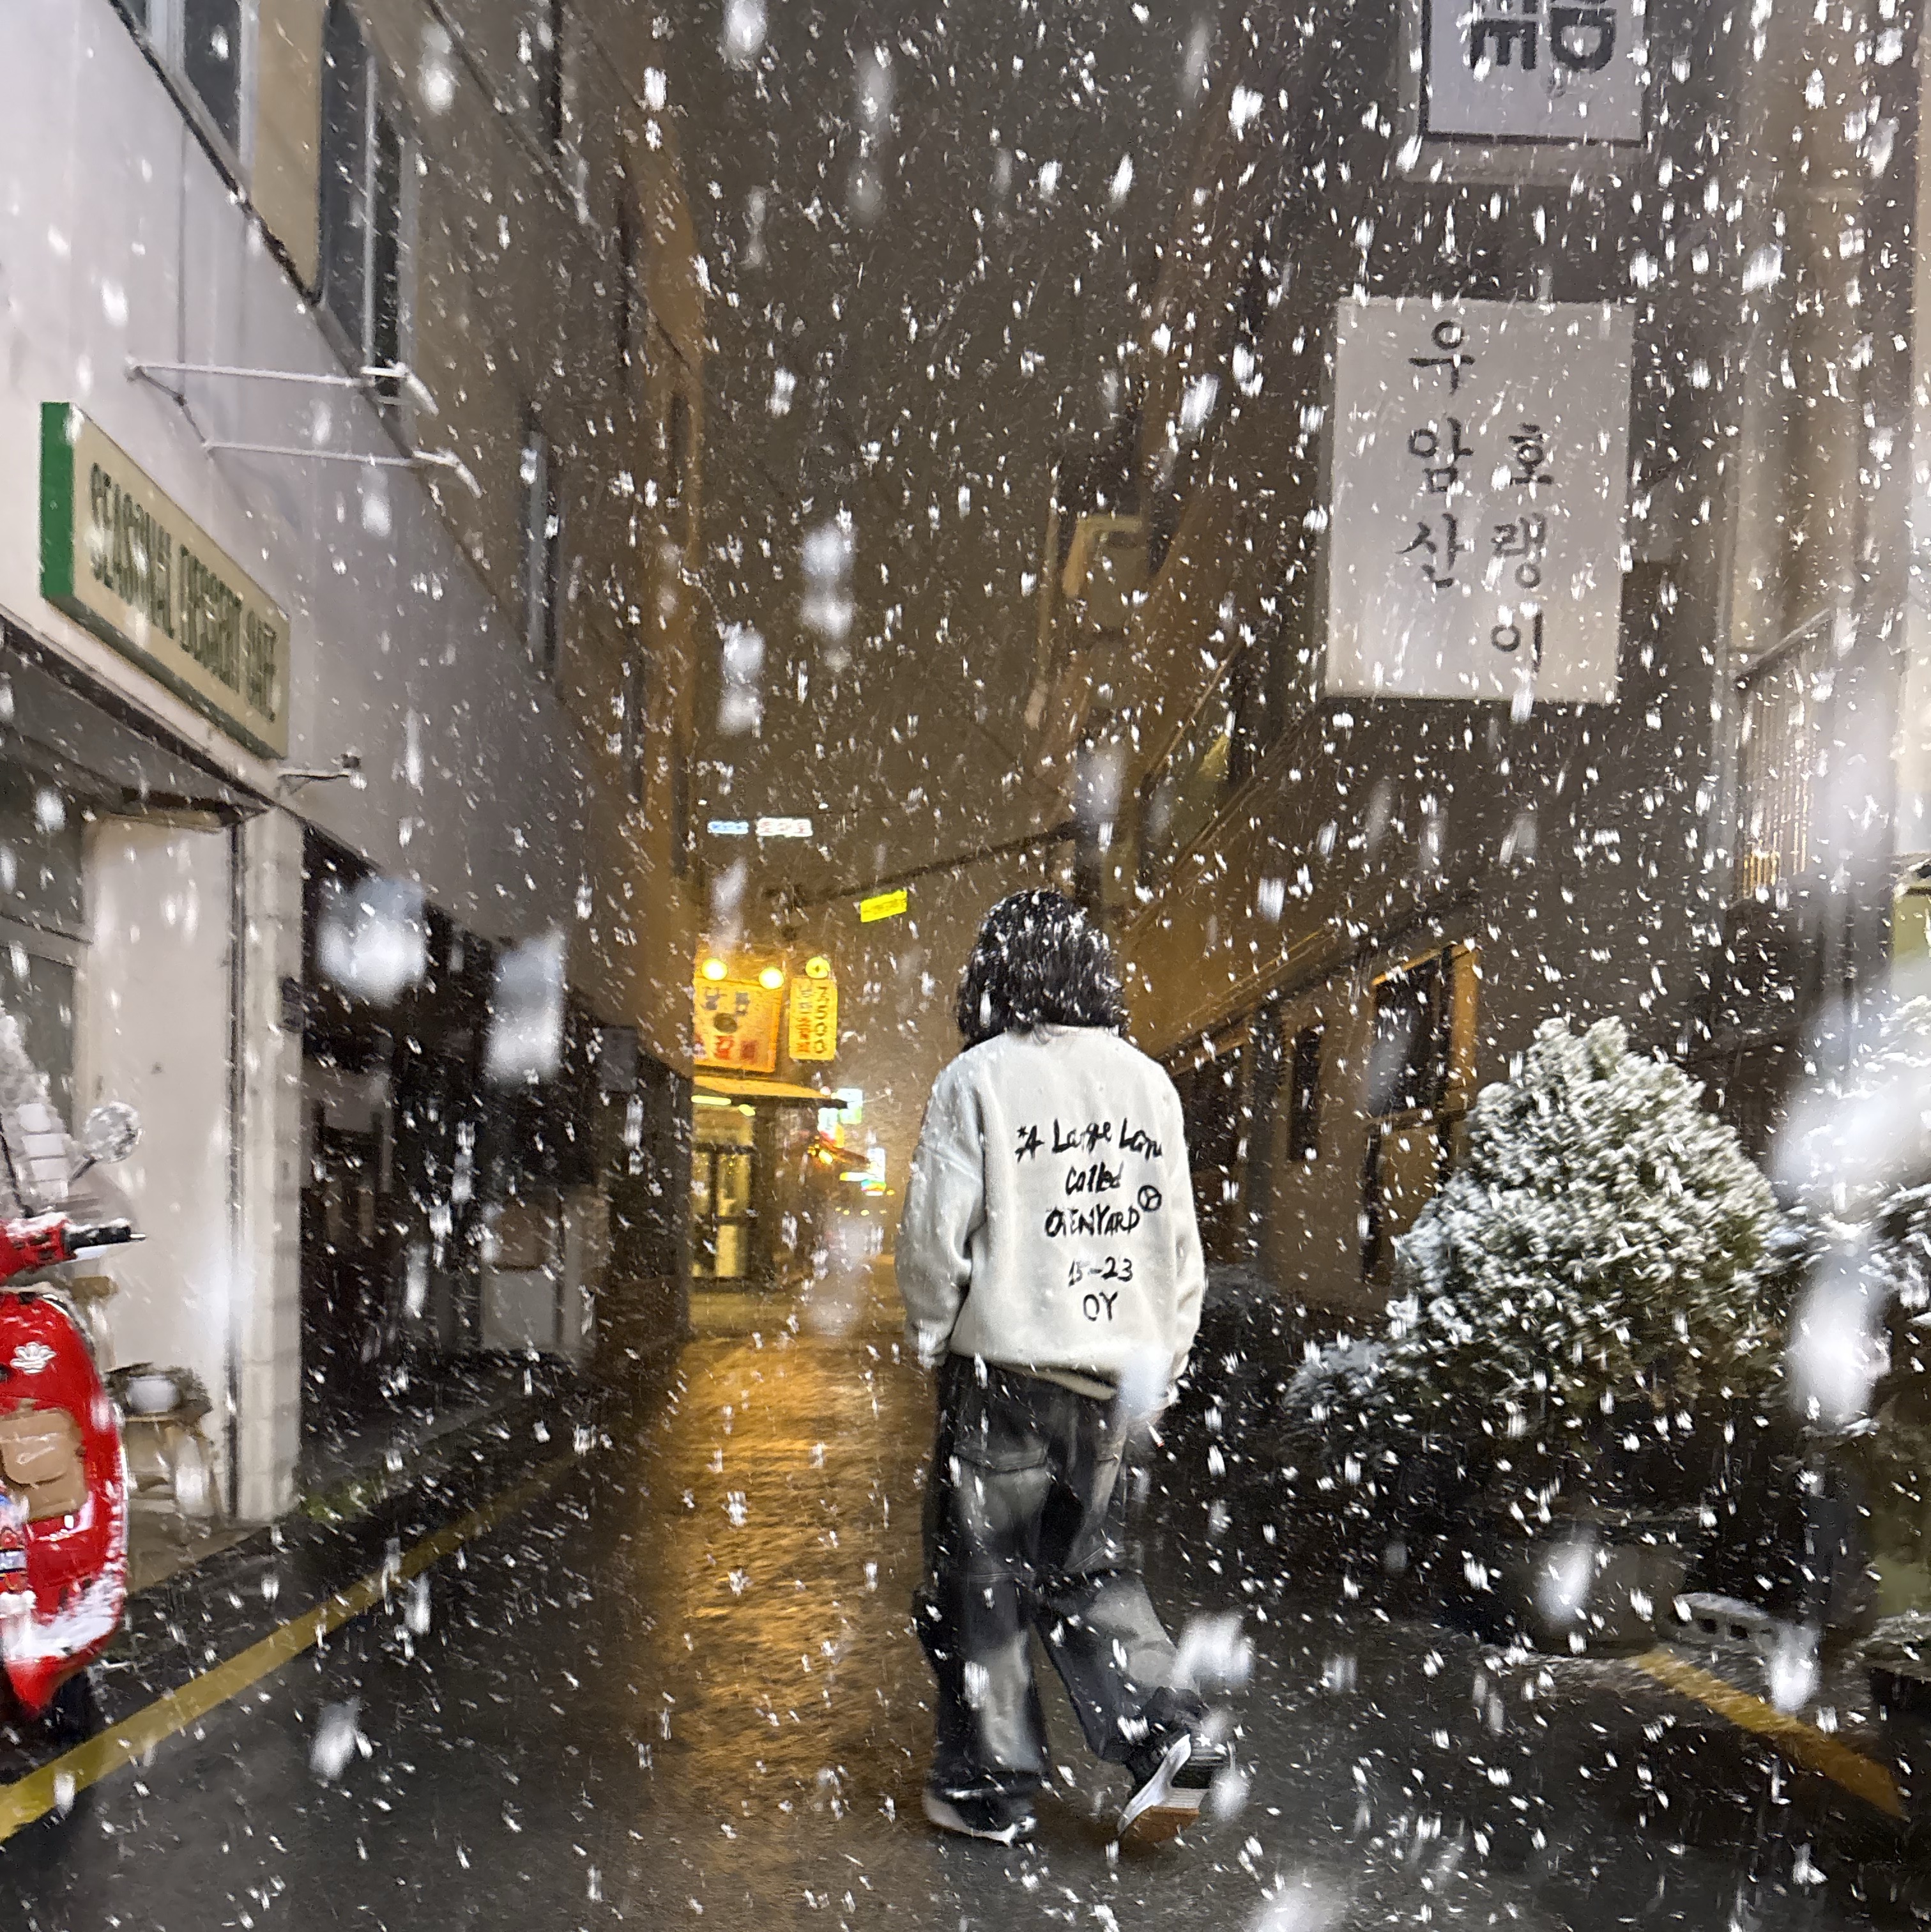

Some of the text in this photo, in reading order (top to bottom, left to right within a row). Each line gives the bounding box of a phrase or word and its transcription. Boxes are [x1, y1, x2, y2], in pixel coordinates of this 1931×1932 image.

[1395, 319, 1476, 588] 우암산
[1491, 422, 1554, 673] 호랭이
[1083, 1291, 1118, 1321] OY
